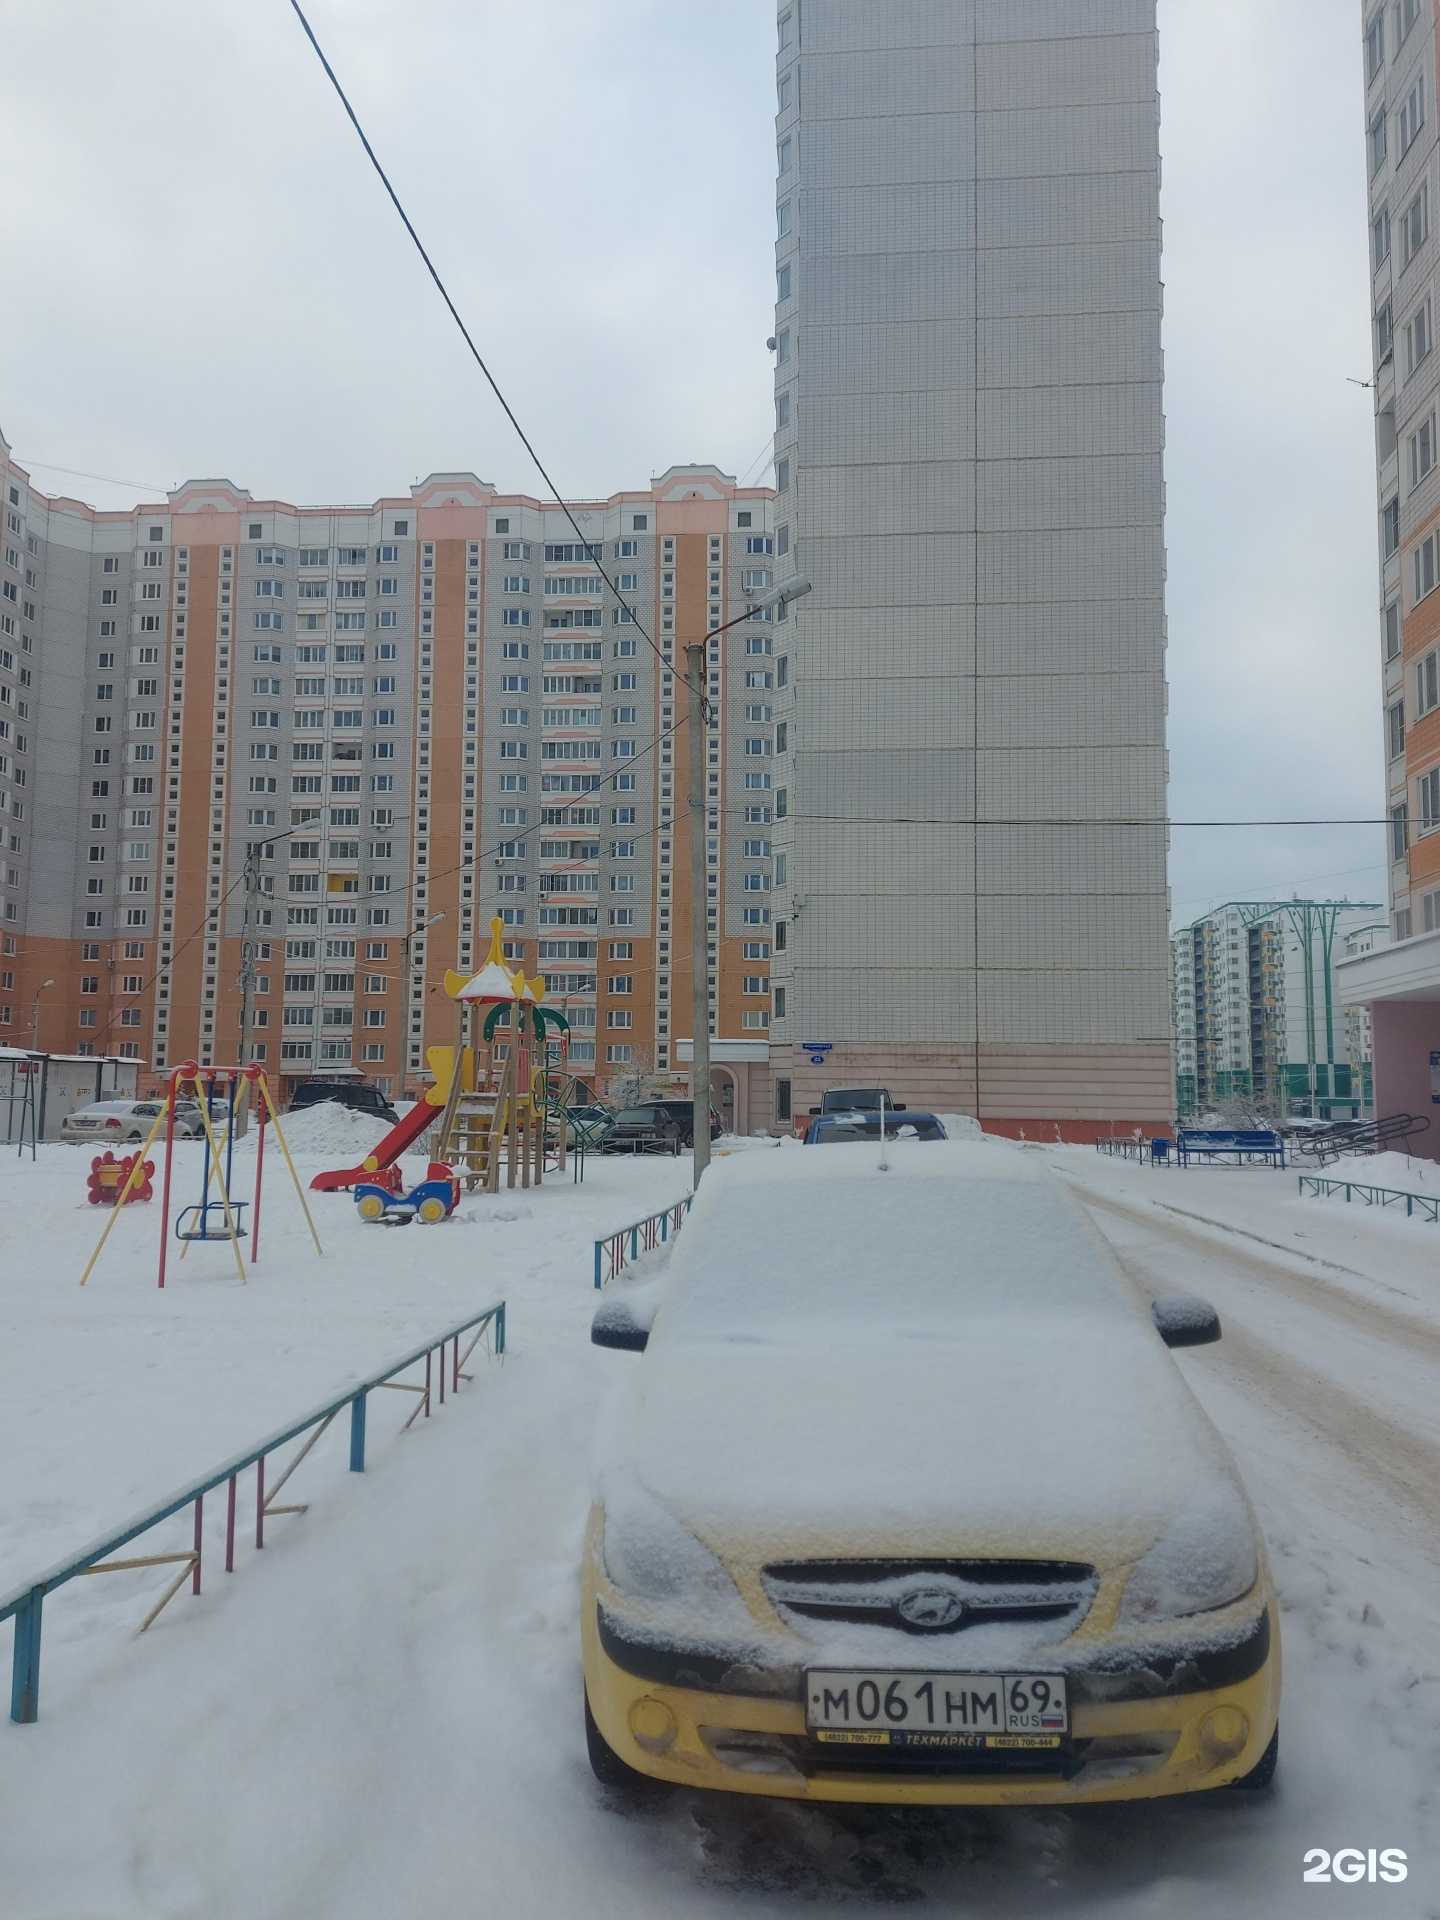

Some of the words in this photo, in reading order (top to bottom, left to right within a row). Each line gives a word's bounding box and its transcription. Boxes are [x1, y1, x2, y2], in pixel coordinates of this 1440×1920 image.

[823, 1680, 998, 1725] М061НМ
[1009, 1680, 1051, 1713] 69
[1009, 1716, 1040, 1728] RUS
